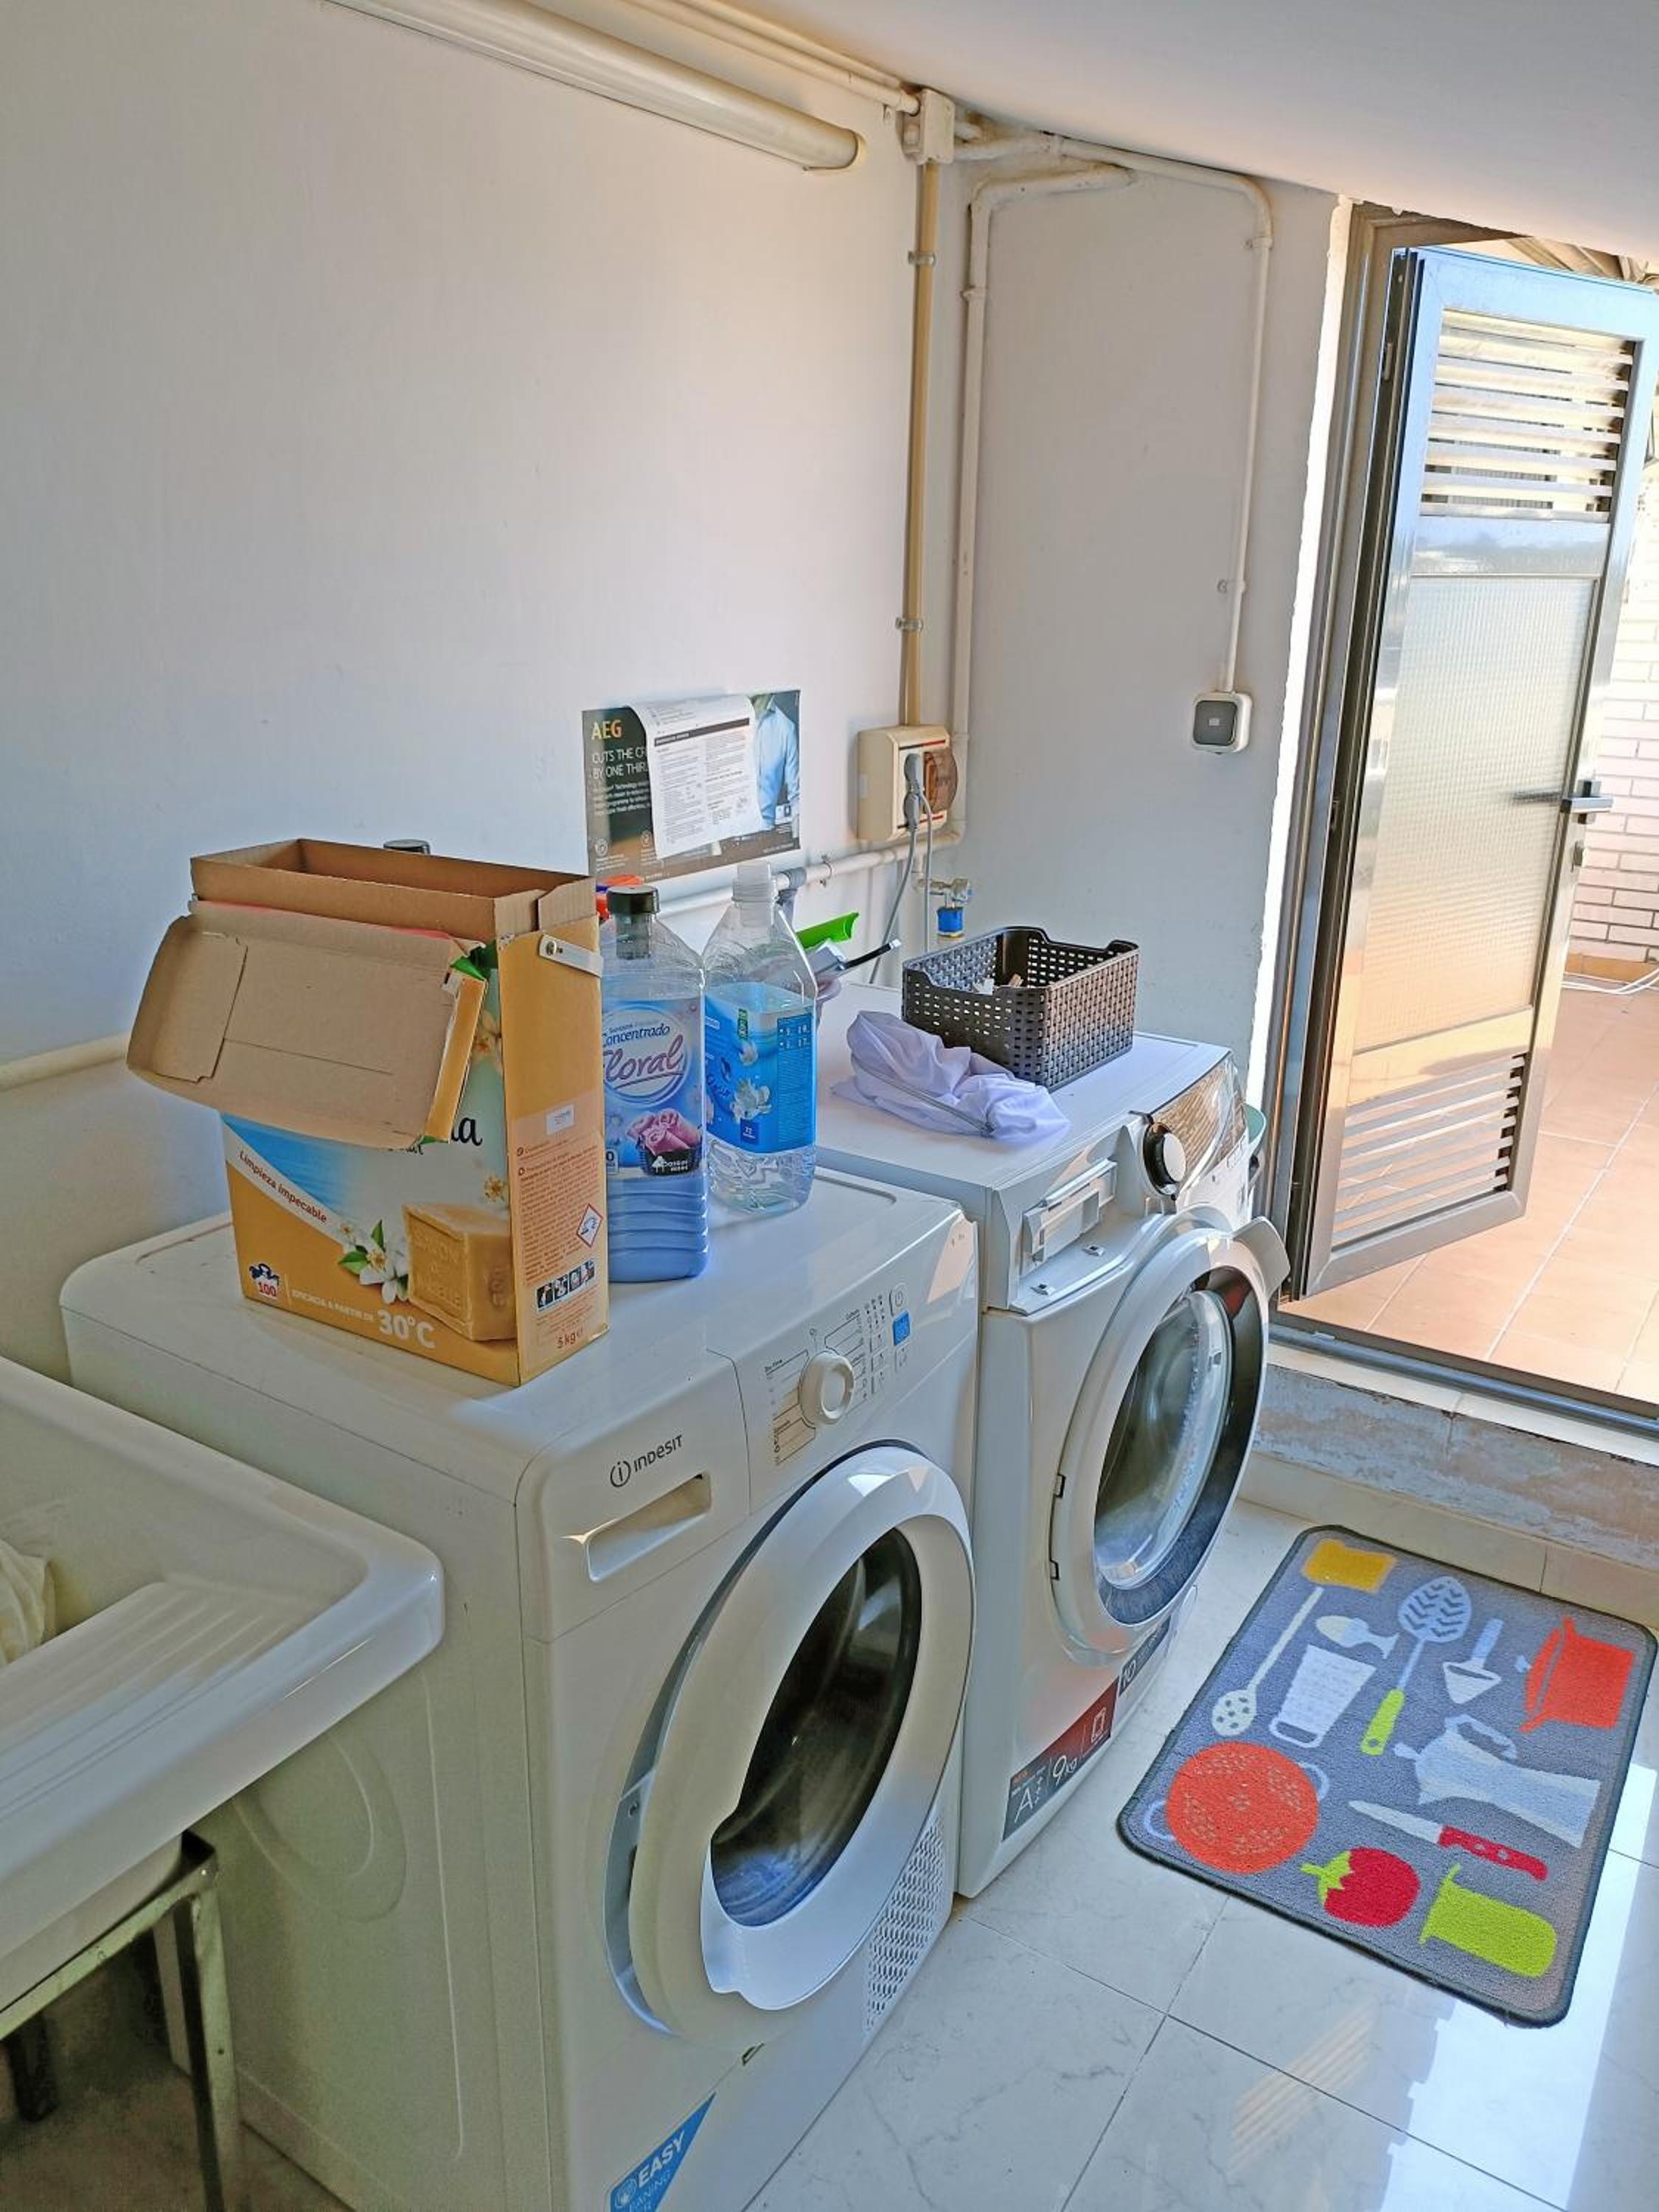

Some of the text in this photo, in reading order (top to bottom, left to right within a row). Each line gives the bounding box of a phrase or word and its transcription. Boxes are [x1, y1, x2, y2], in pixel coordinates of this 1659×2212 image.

[591, 720, 622, 740] AEG
[616, 748, 634, 761] THE
[605, 765, 625, 778] ONE
[603, 1034, 684, 1082] loral
[240, 1151, 327, 1222] Limpieza impecable
[258, 1281, 276, 1297] 100
[638, 2130, 684, 2188] EASY
